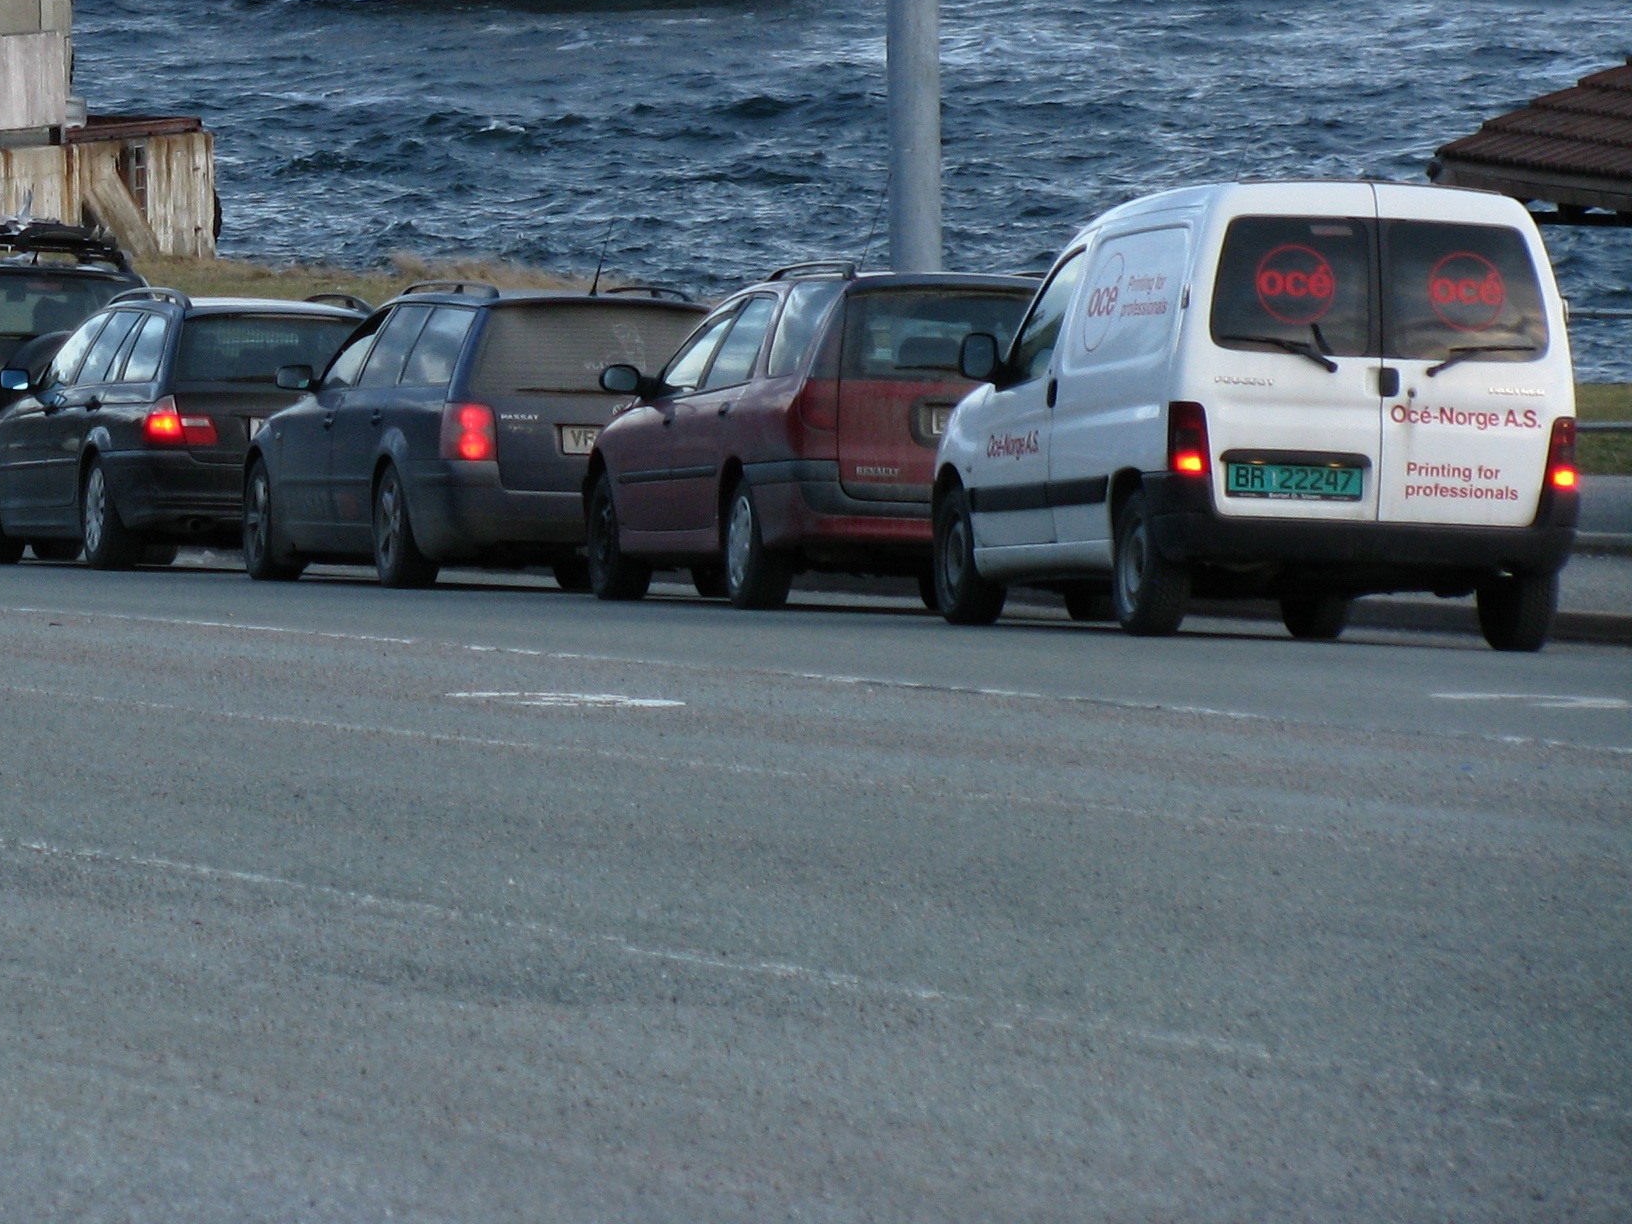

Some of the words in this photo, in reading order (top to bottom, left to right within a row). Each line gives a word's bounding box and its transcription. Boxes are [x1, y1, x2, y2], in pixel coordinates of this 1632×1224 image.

[1259, 264, 1332, 297] océ
[1431, 271, 1503, 305] océ
[1391, 404, 1500, 430] Océ-Norge
[1504, 409, 1542, 429] A.S.
[1235, 466, 1265, 489] BR
[1279, 467, 1354, 491] 22247
[1406, 462, 1472, 482] Printing
[1478, 465, 1501, 480] for
[1405, 483, 1519, 501] professionals
